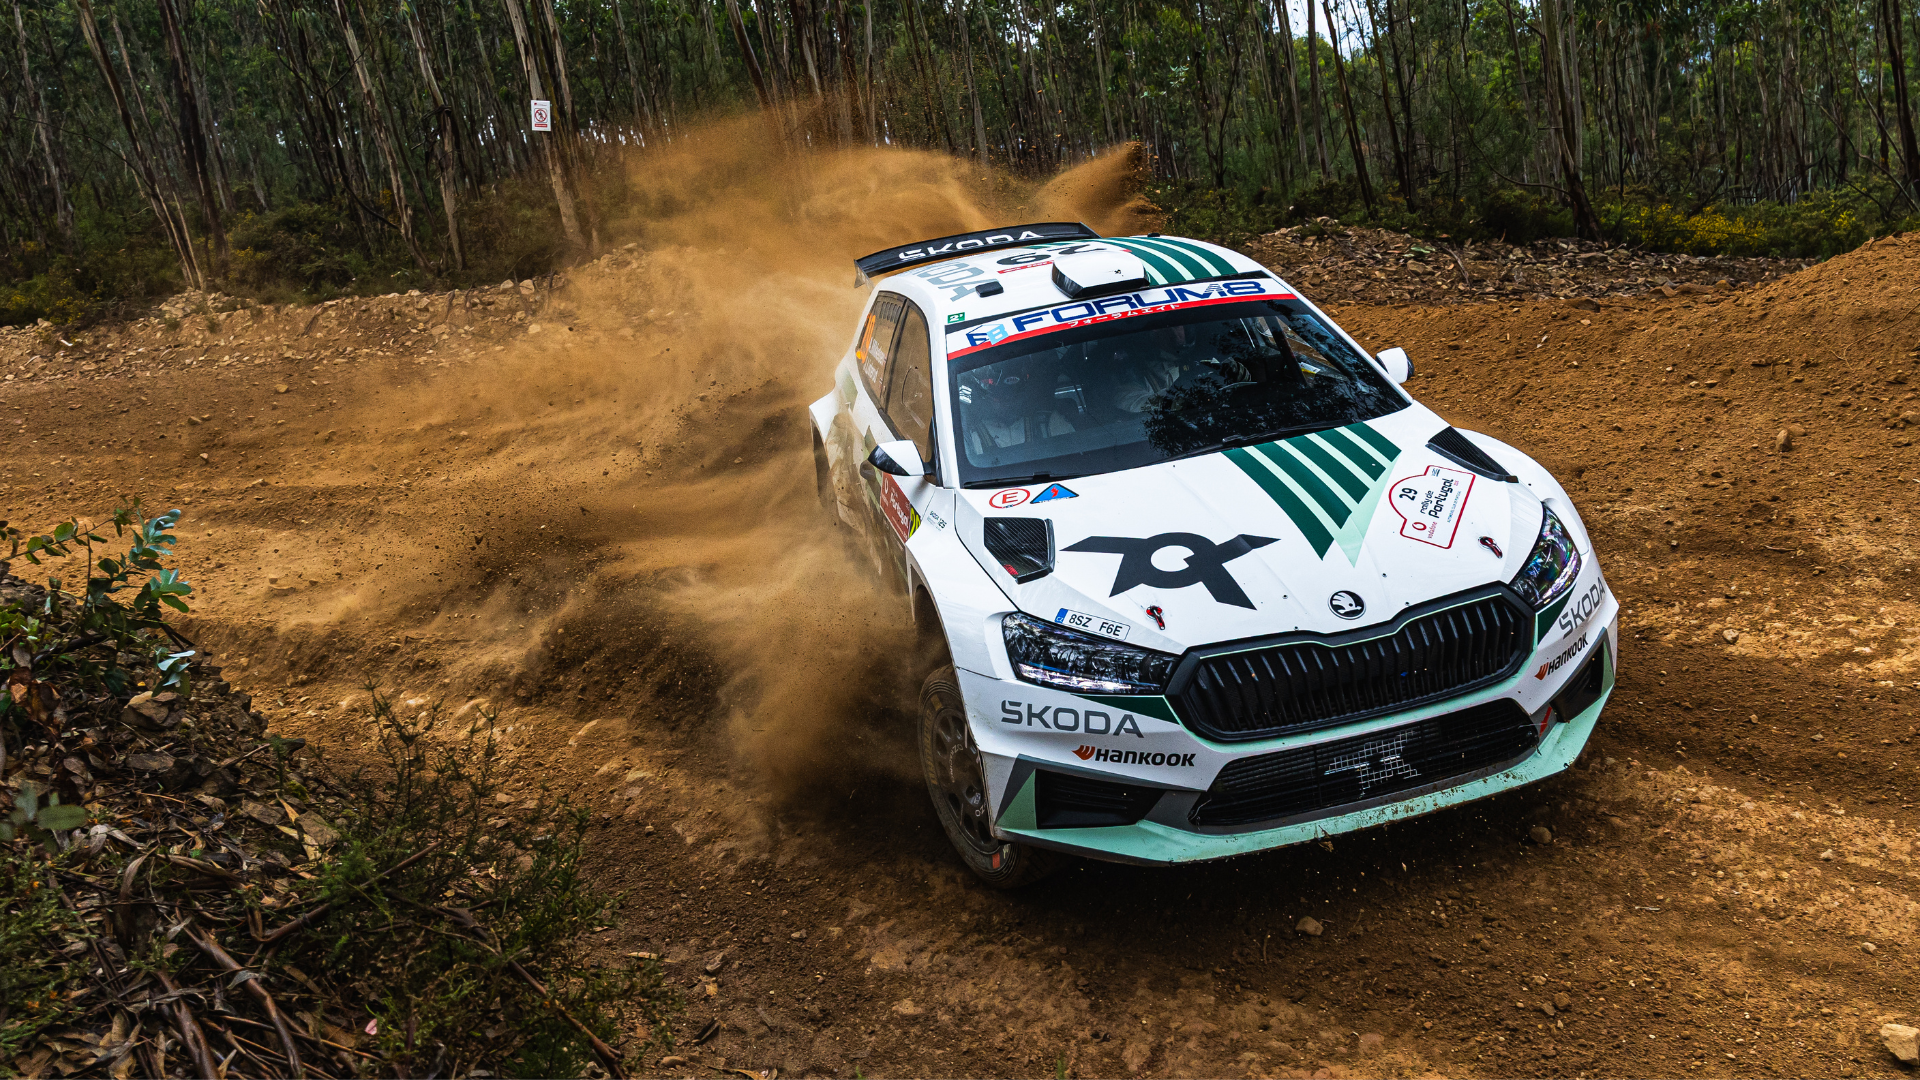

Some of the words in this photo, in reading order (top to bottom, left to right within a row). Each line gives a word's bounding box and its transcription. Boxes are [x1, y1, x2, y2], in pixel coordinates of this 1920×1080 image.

[1011, 280, 1266, 331] FORUM8
[1067, 303, 1180, 328] フォーラムエイト
[1002, 491, 1018, 504] E
[1398, 487, 1418, 501] 29
[1428, 478, 1454, 519] Portugal
[1068, 613, 1093, 628] 8SZ
[1098, 621, 1123, 637] F6E
